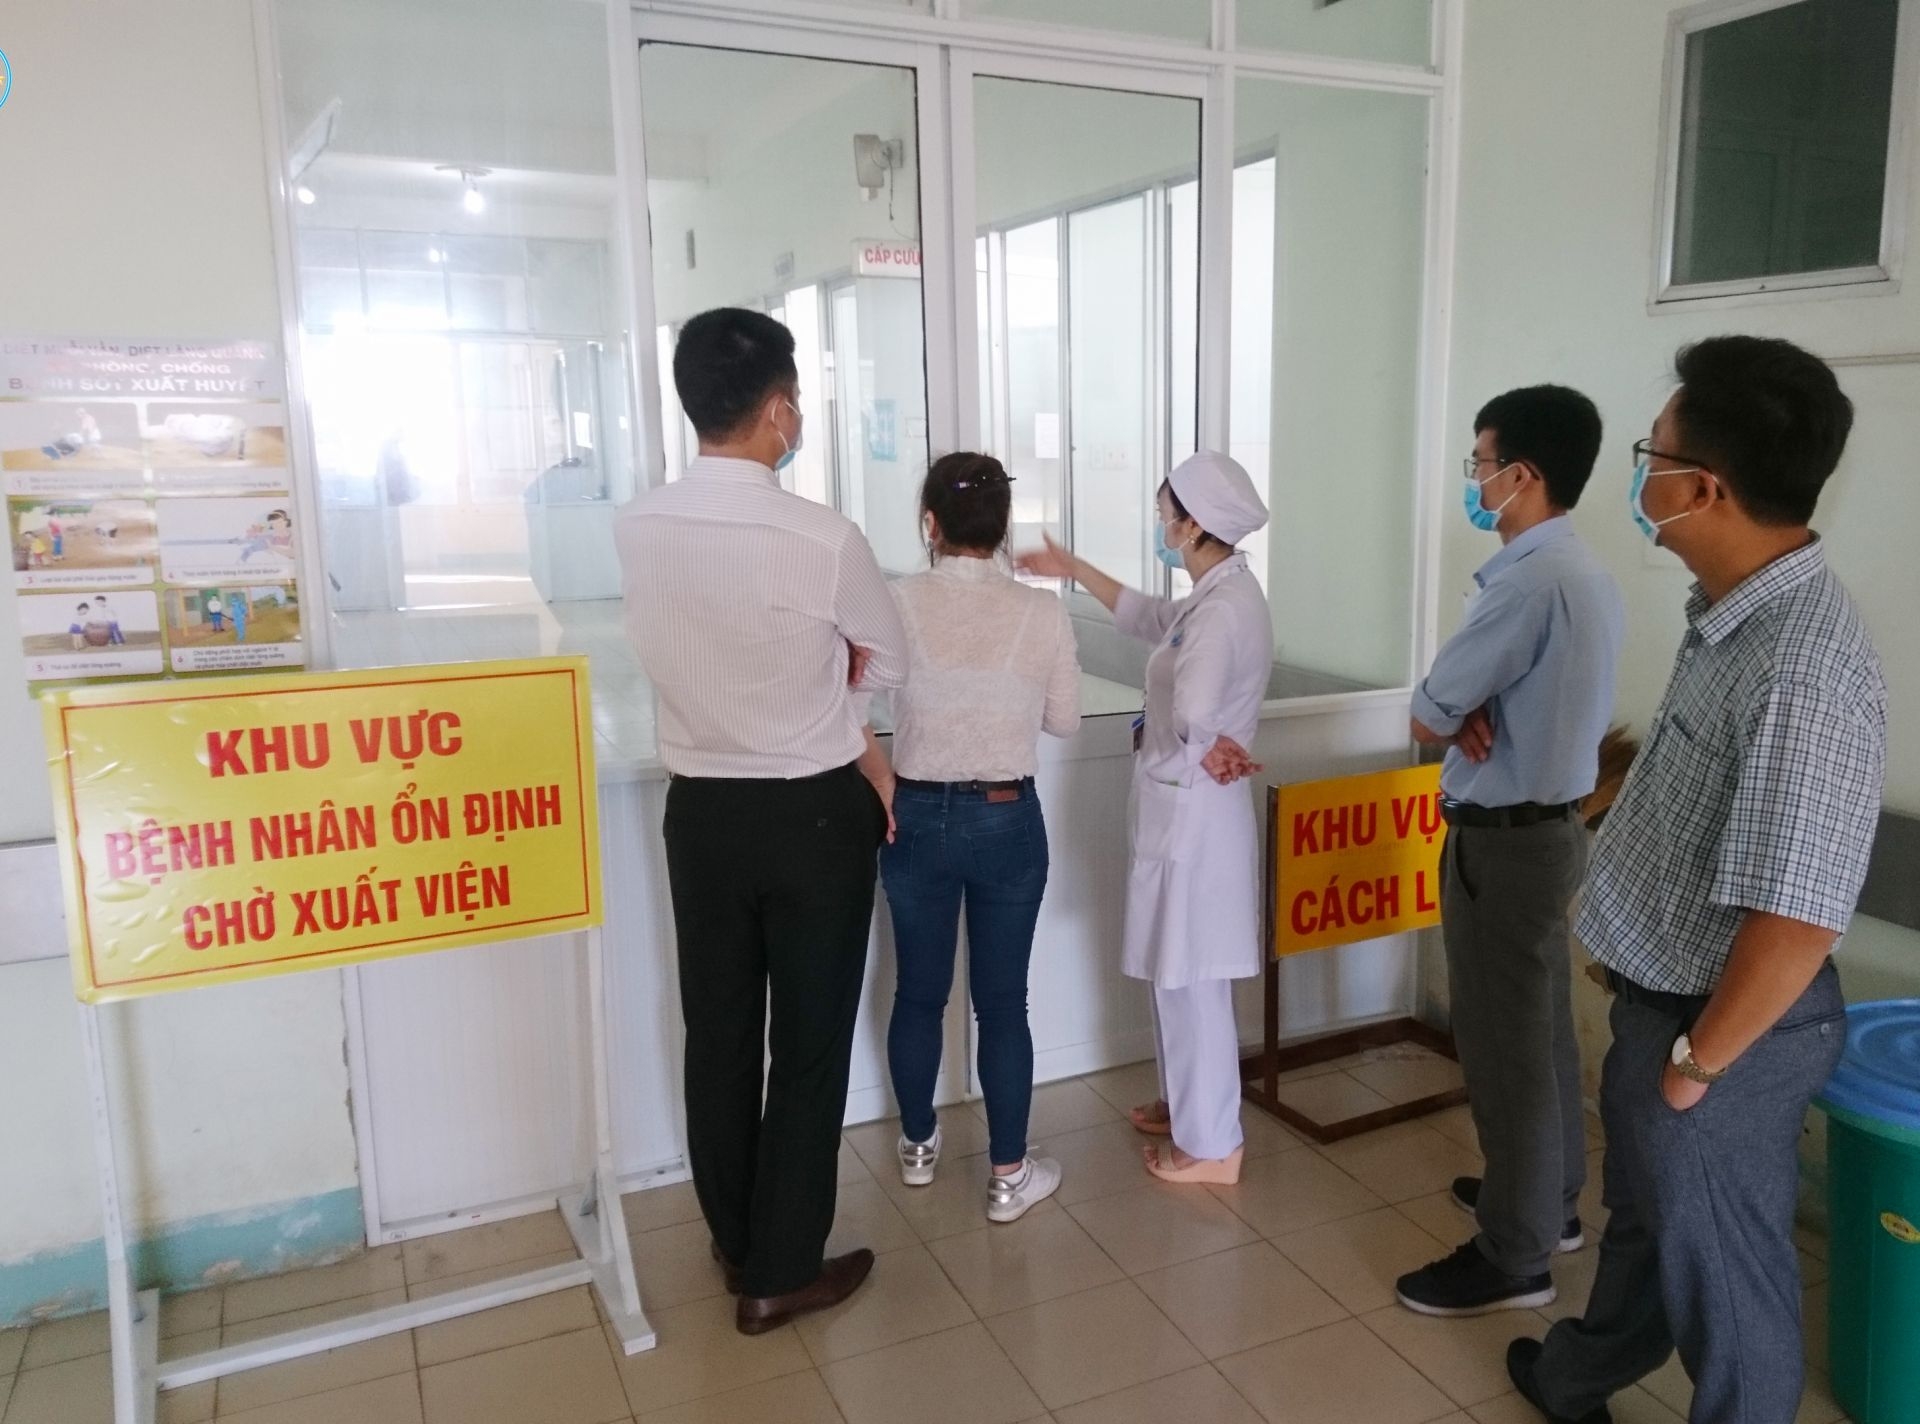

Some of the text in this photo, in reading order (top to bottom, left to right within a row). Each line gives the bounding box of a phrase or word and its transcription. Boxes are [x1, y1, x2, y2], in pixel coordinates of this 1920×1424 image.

[865, 242, 891, 263] CẤP
[131, 374, 188, 392] XUẤT
[160, 360, 231, 375] CHỐNG
[206, 709, 462, 777] KHU VỰC
[105, 782, 562, 885] BỆNH NHÂN ỔN ĐỊNH
[1293, 802, 1377, 857] KHU
[182, 861, 511, 950] CHỜ XUẤT VIỆN
[1291, 870, 1436, 935] CÁCH L
